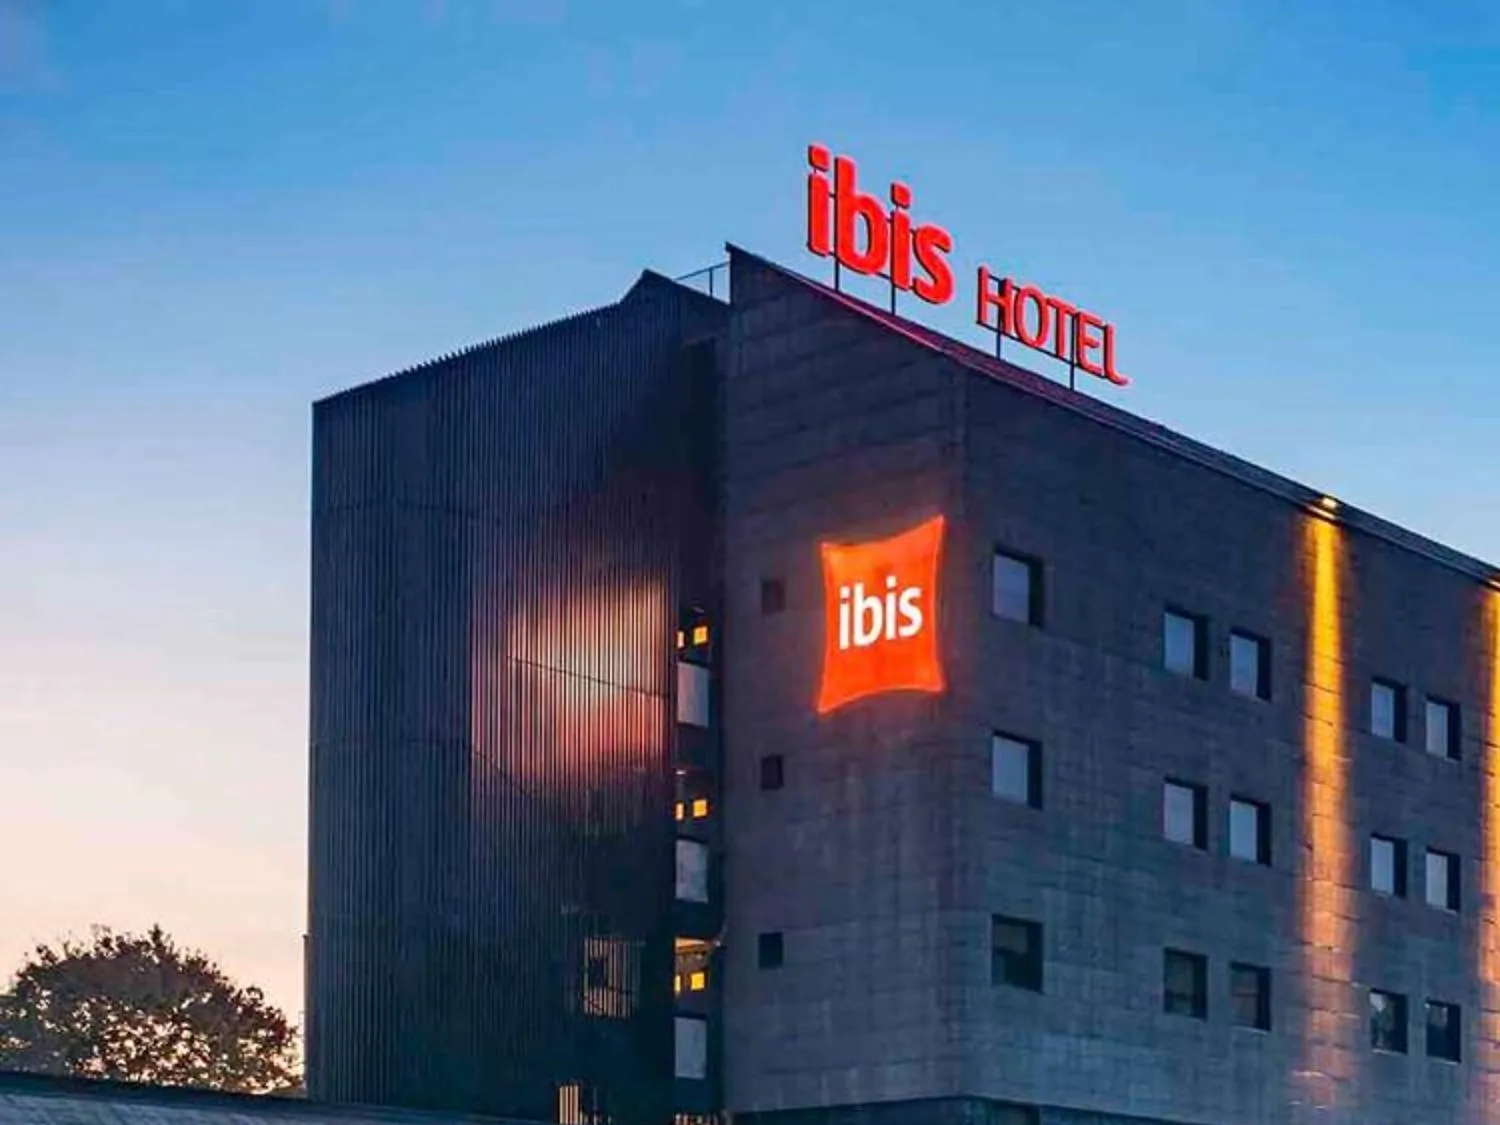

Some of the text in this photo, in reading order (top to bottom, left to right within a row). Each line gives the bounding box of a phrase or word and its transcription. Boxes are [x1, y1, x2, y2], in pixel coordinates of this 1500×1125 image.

[807, 143, 1132, 387] ibis HOTEL
[839, 575, 923, 651] ibis
